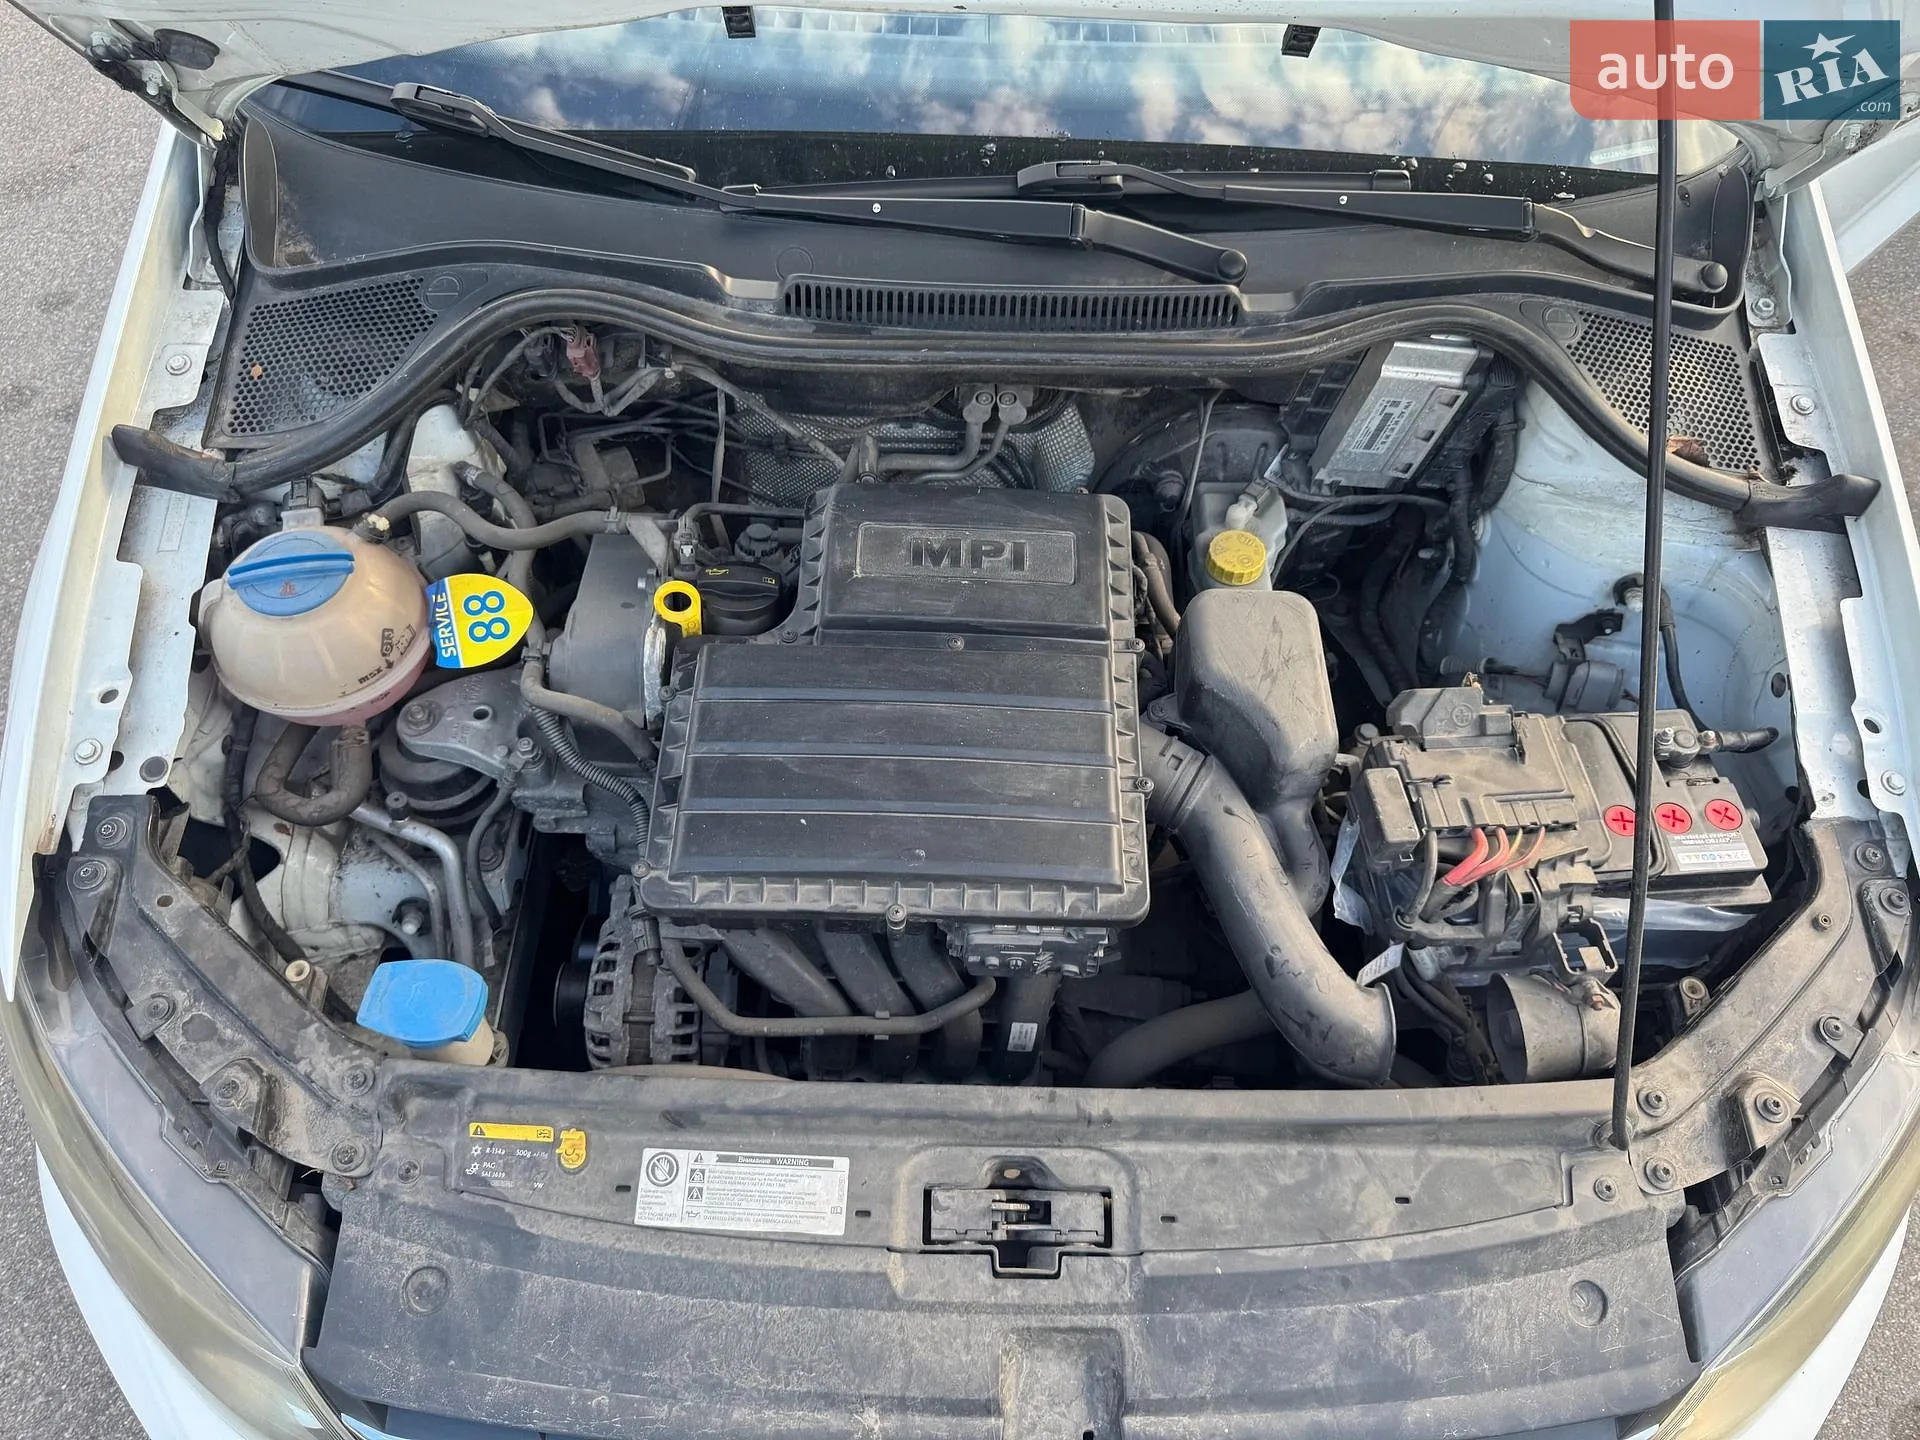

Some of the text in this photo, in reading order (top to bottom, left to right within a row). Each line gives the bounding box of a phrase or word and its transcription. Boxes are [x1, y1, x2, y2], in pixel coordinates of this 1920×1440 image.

[910, 537, 1028, 572] MPI
[432, 592, 457, 658] SERVICE
[463, 590, 510, 644] 88
[516, 1149, 531, 1158] 500g
[775, 1157, 810, 1167] WARNING
